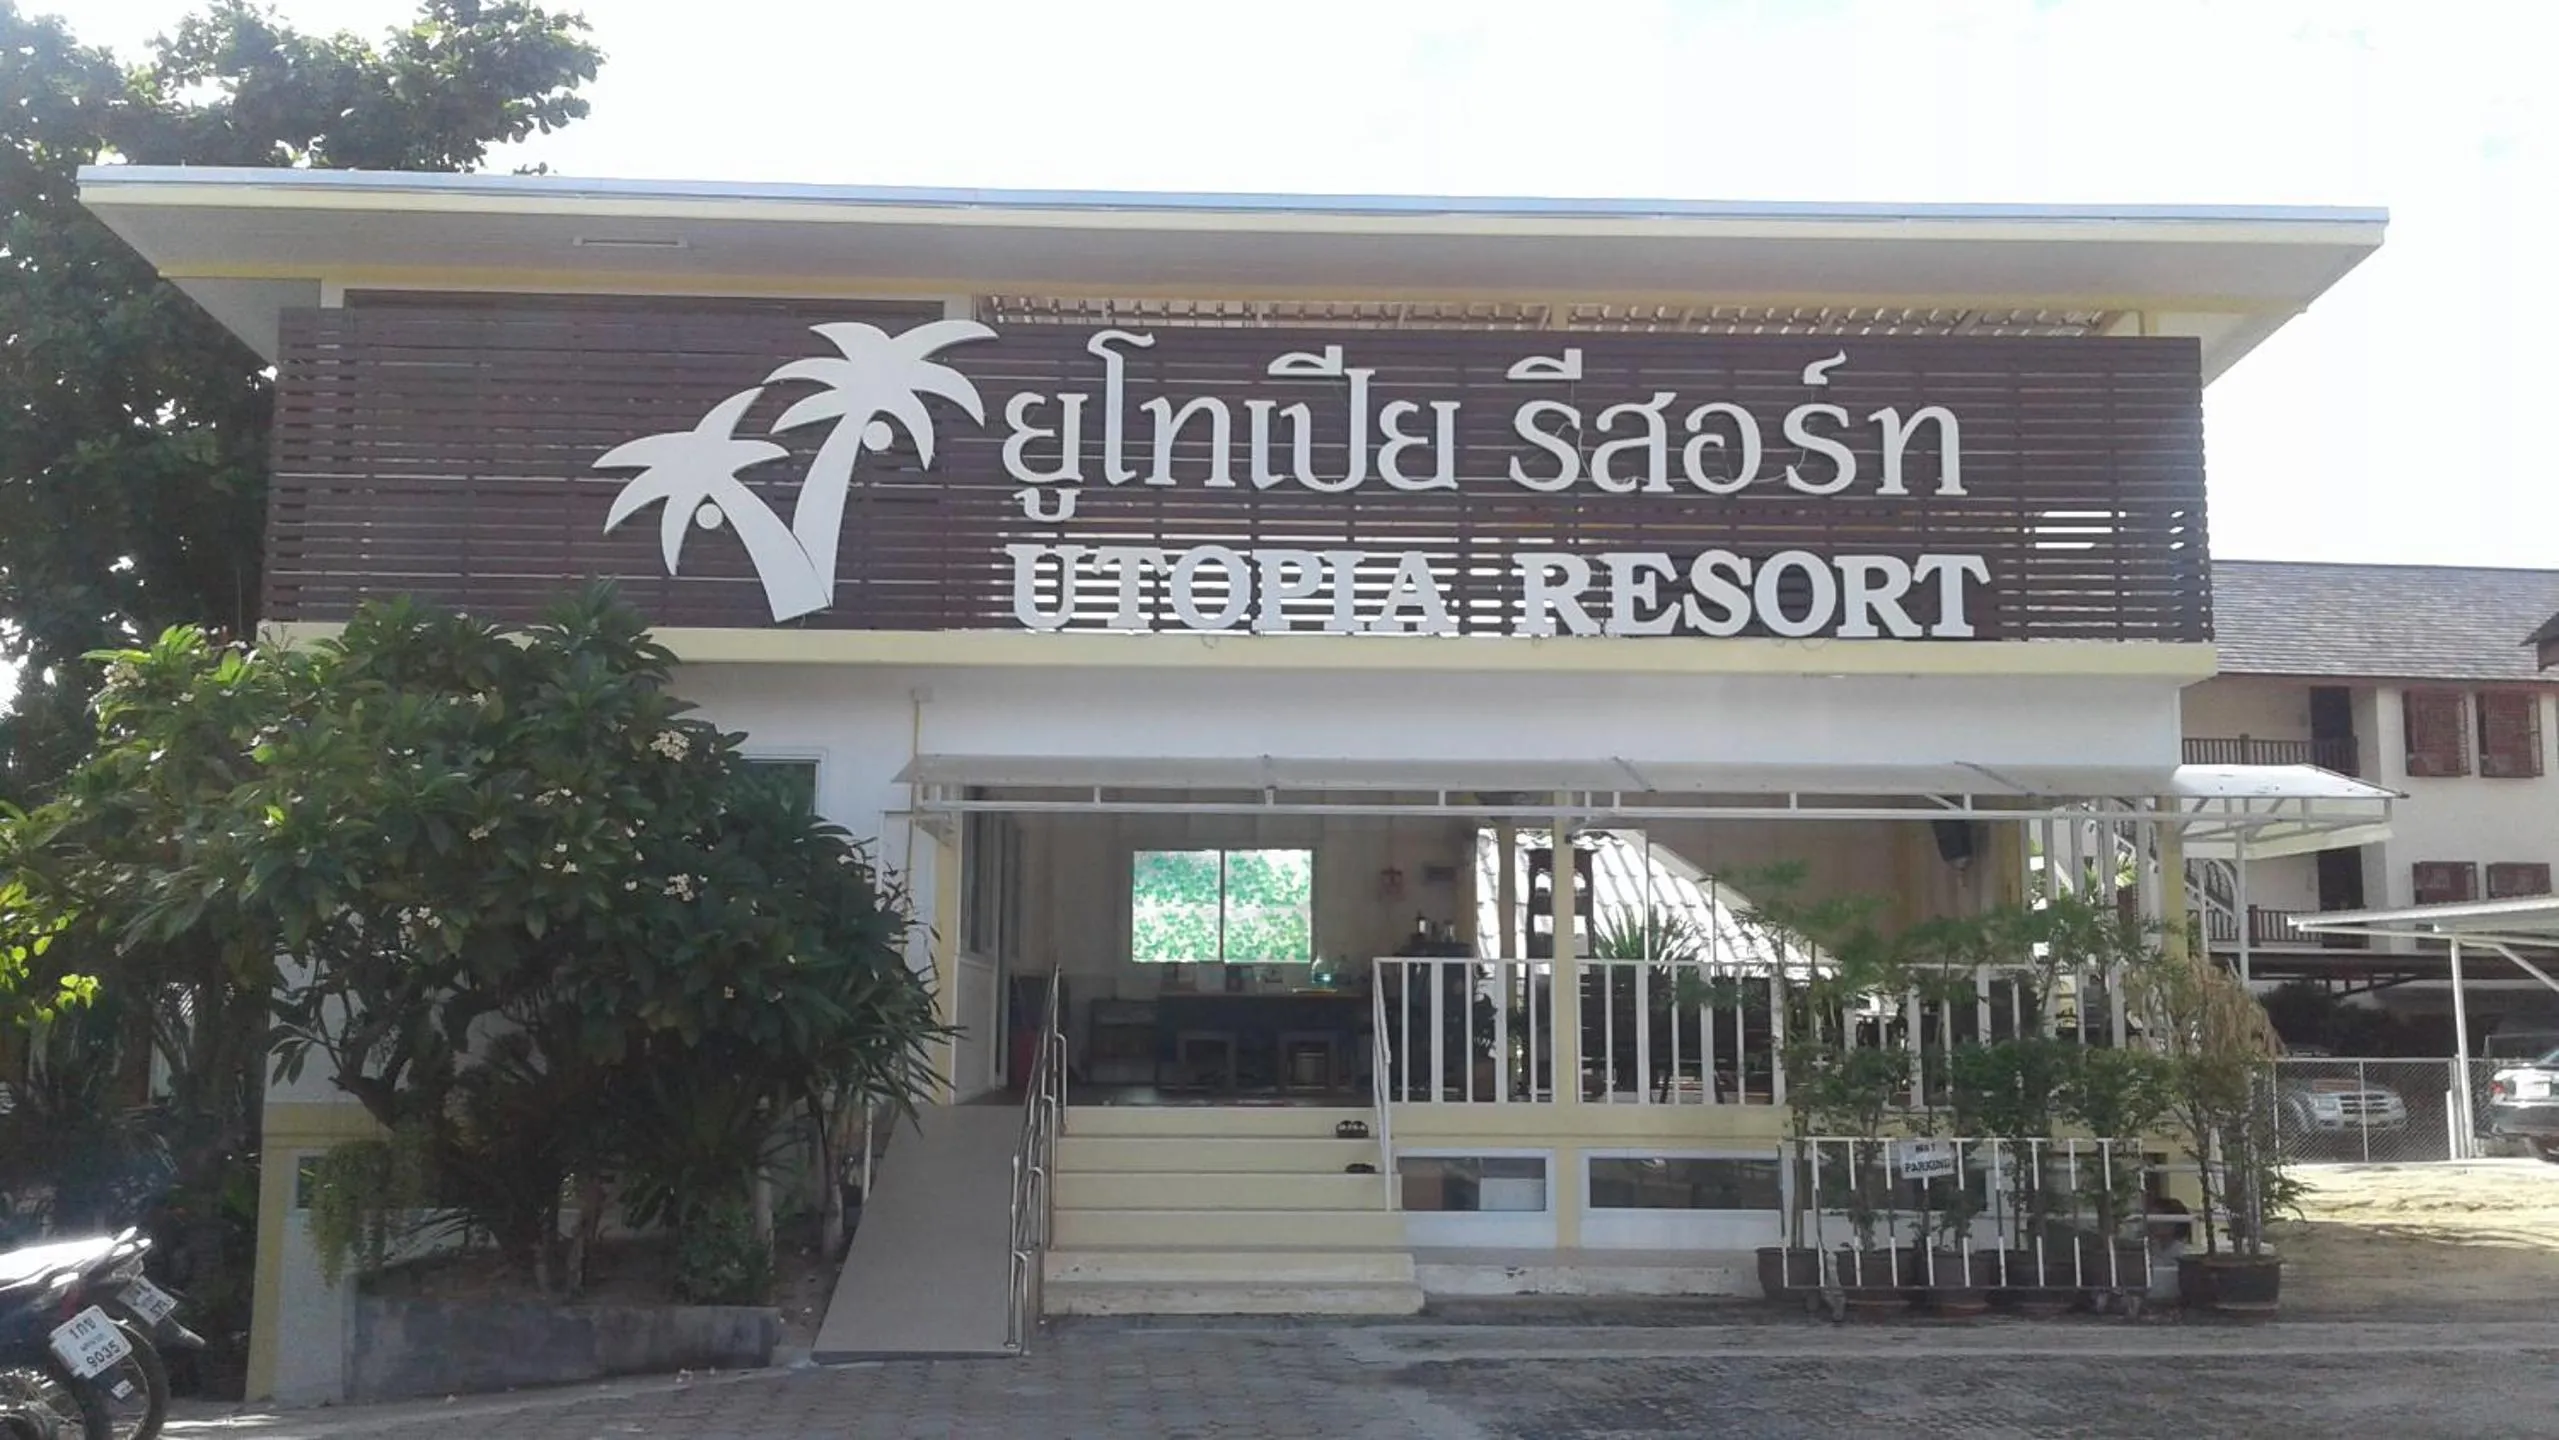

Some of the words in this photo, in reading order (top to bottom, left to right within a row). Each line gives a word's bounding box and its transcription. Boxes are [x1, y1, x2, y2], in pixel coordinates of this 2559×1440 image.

[1002, 329, 1461, 523] ยูโทเปีย
[1507, 348, 1968, 496] รีสอร์ท
[1005, 543, 1459, 634] UTOPIA
[1512, 549, 1991, 638] RESORT
[86, 1339, 121, 1368] 9035
